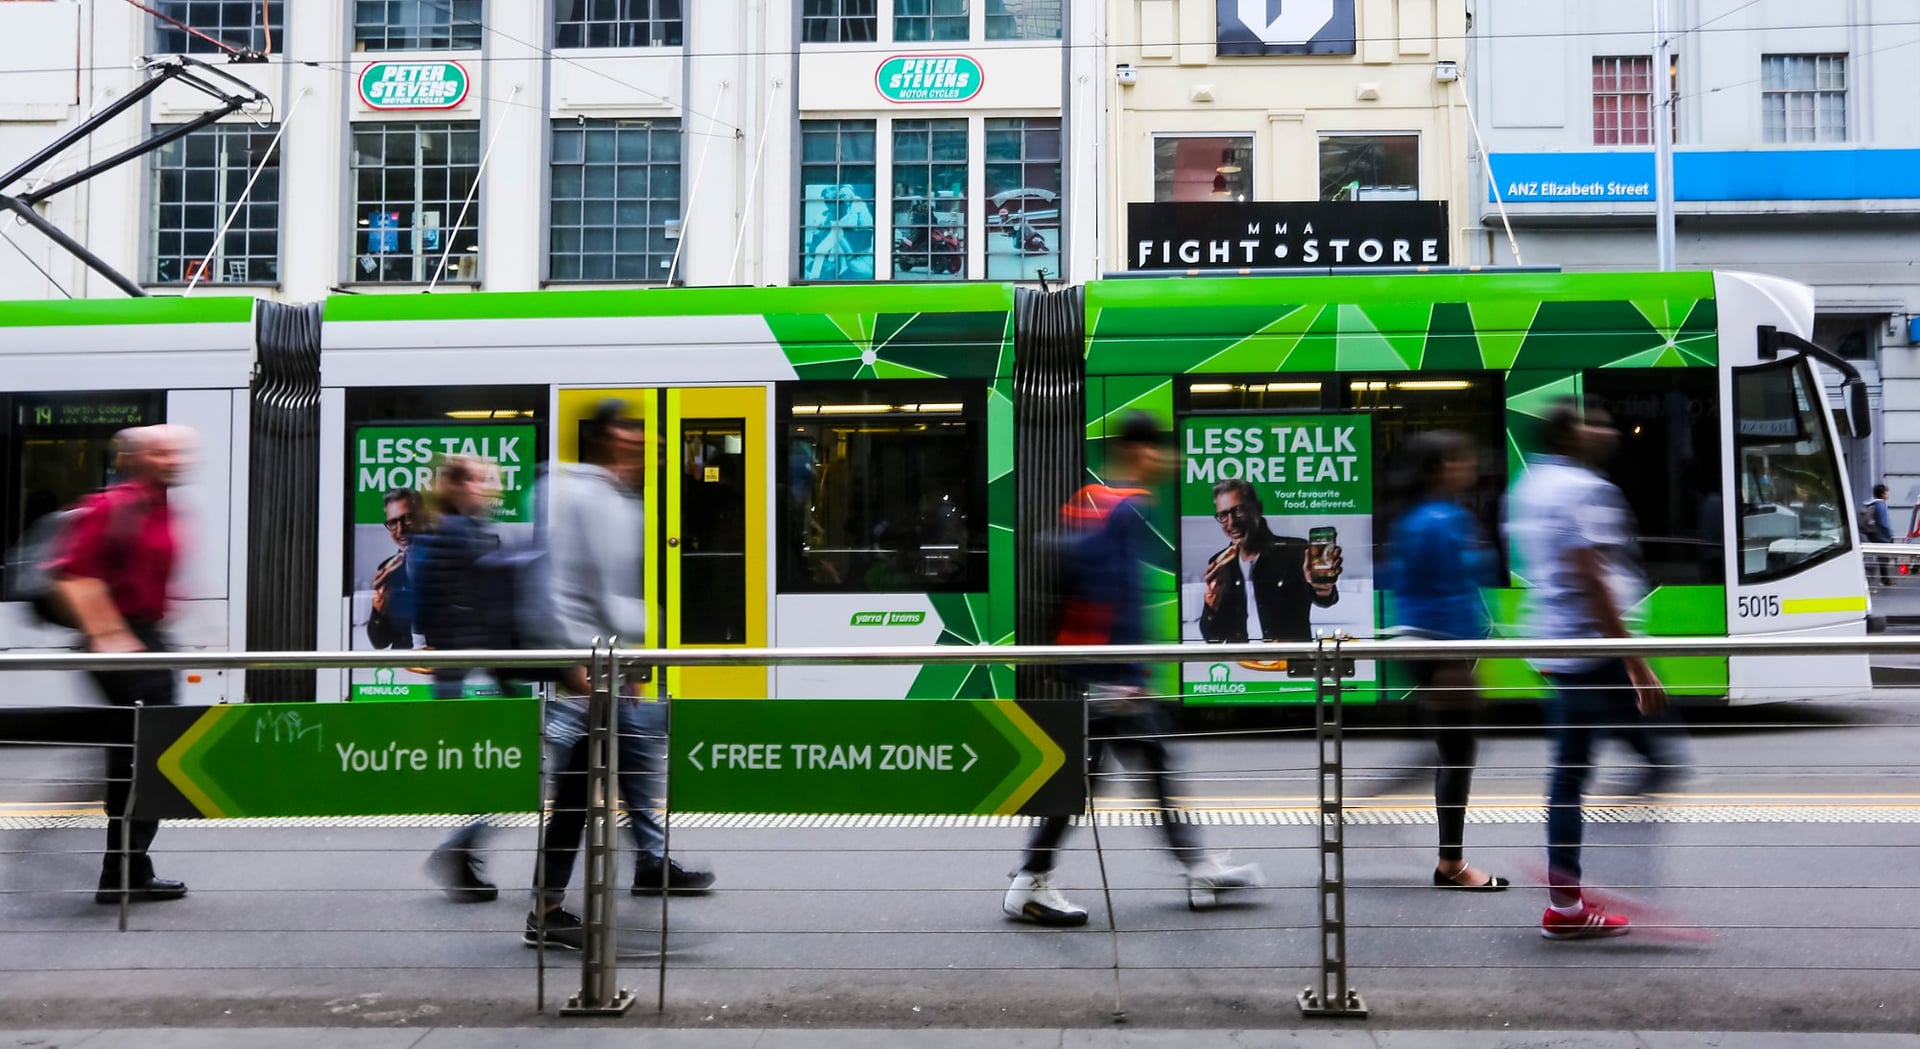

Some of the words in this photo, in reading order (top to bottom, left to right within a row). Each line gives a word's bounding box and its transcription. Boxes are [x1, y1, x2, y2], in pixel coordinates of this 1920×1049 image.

[381, 65, 446, 82] PETER
[902, 59, 958, 74] PETER
[369, 80, 458, 98] STEVENS
[889, 73, 970, 88] STEVENS
[900, 89, 927, 98] MOTOR
[929, 89, 960, 98] CYCLES
[1508, 182, 1538, 196] ANZ
[1541, 181, 1604, 196] Elizabeth
[1607, 182, 1649, 196] Street
[1138, 240, 1260, 267] FIGHT
[1303, 239, 1438, 263] STORE
[34, 406, 51, 425] 19
[1186, 428, 1264, 454] LESS
[1271, 426, 1356, 453] TALK
[359, 438, 433, 464] LESS
[440, 437, 520, 463] TALK
[1186, 456, 1286, 483] MORE
[1296, 456, 1359, 482] EAT.
[359, 466, 446, 492] MOR
[1274, 490, 1296, 499] Your
[1297, 489, 1340, 498] favourite
[1284, 500, 1309, 509] food,
[1310, 499, 1356, 509] delivered.
[1738, 595, 1779, 618] 5015
[855, 614, 882, 625] yarra
[891, 613, 920, 623] trams
[359, 686, 409, 695] MENULOG
[1193, 683, 1246, 693] MENULOG
[335, 740, 428, 772] You're
[437, 739, 463, 770] in
[472, 739, 522, 769] the
[711, 743, 782, 770] FREE
[790, 743, 872, 770] TRAM
[879, 744, 954, 771] ZONE
